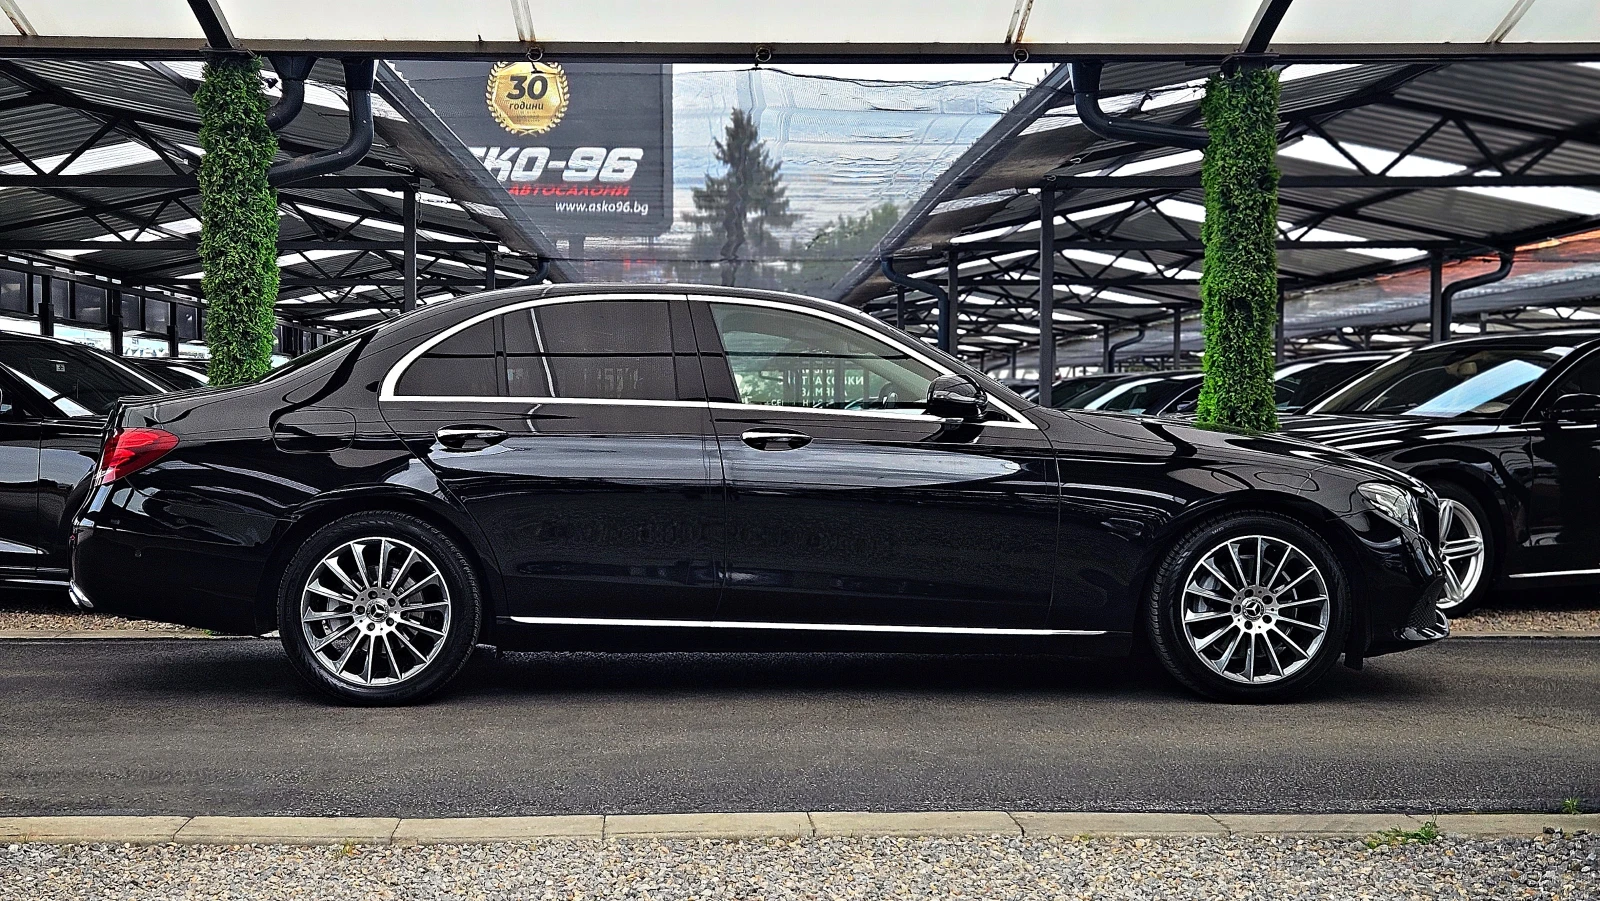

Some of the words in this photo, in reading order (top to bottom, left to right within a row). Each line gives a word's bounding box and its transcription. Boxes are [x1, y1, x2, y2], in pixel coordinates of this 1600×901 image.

[506, 75, 548, 100] 30
[509, 101, 544, 110] години
[509, 184, 631, 196] АВТОСАЛОНИ
[555, 200, 649, 216] www.asko96.bg
